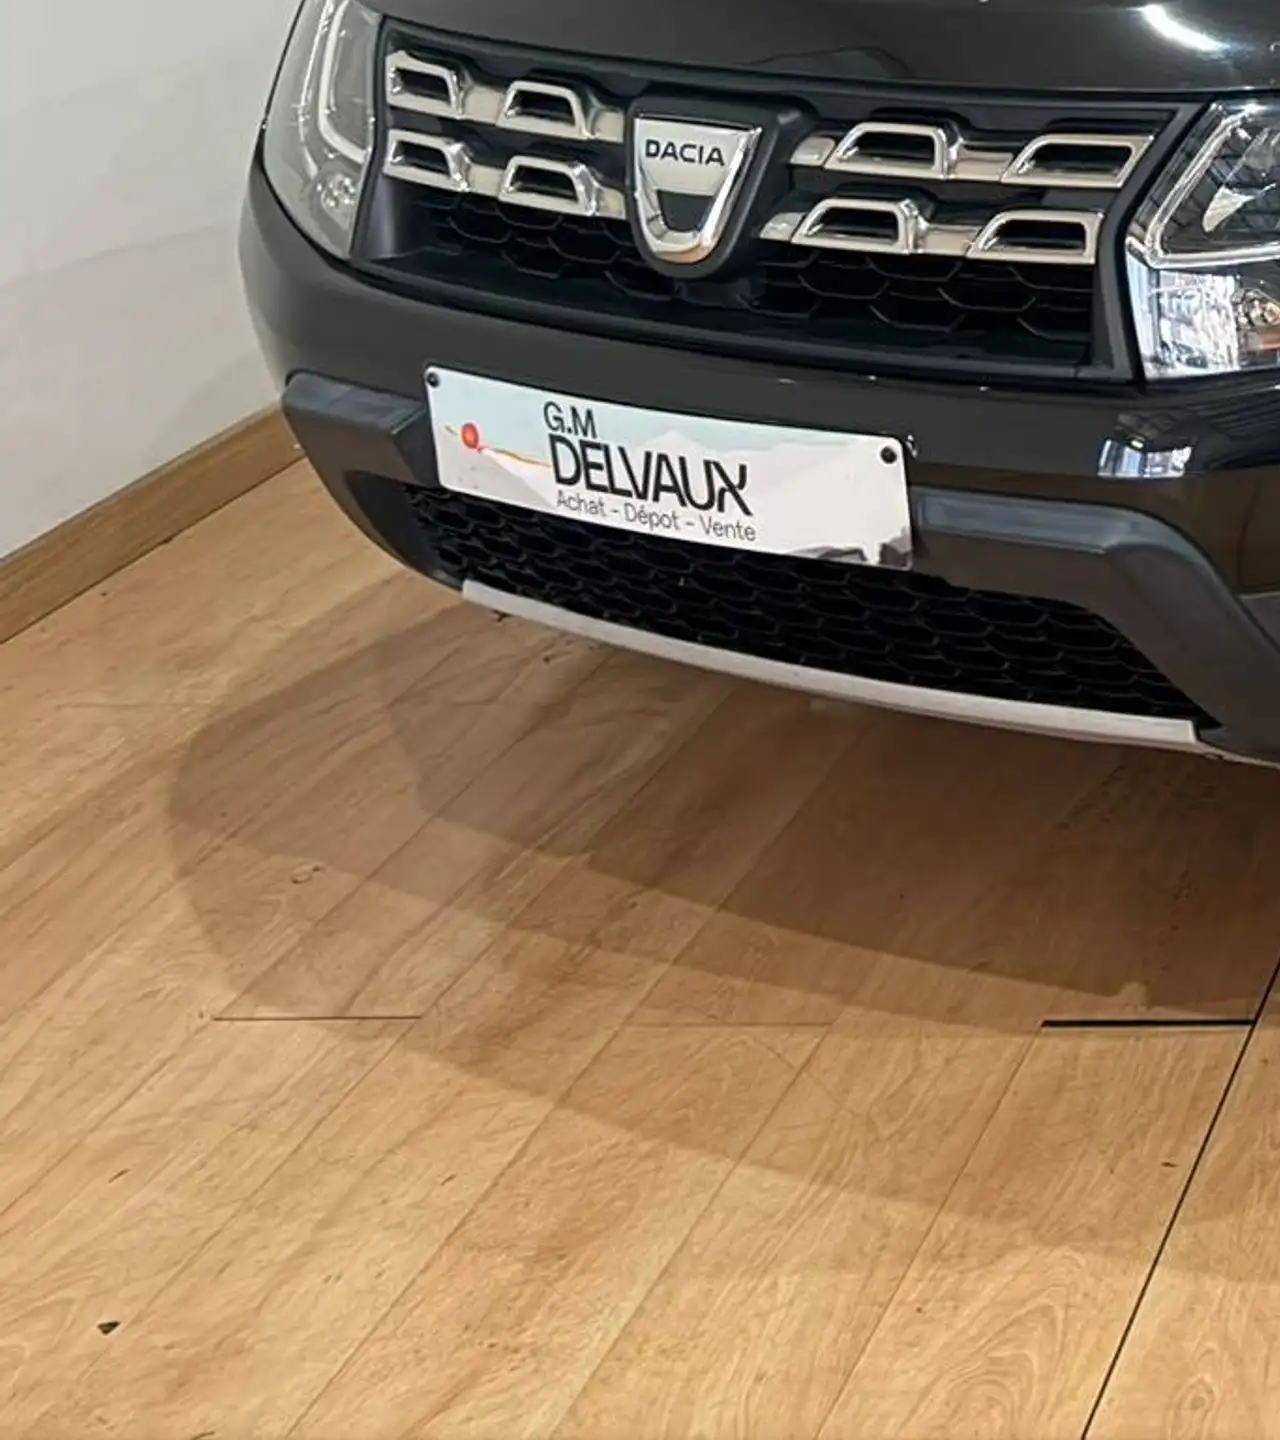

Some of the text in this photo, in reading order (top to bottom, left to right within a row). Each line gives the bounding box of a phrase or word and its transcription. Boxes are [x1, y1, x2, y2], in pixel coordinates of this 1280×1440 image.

[645, 139, 725, 166] DACIA
[544, 401, 596, 439] G.M
[550, 434, 752, 516] DELVAUX
[557, 489, 605, 517] Achat
[624, 501, 680, 532] Dépot
[702, 515, 757, 543] Vente
